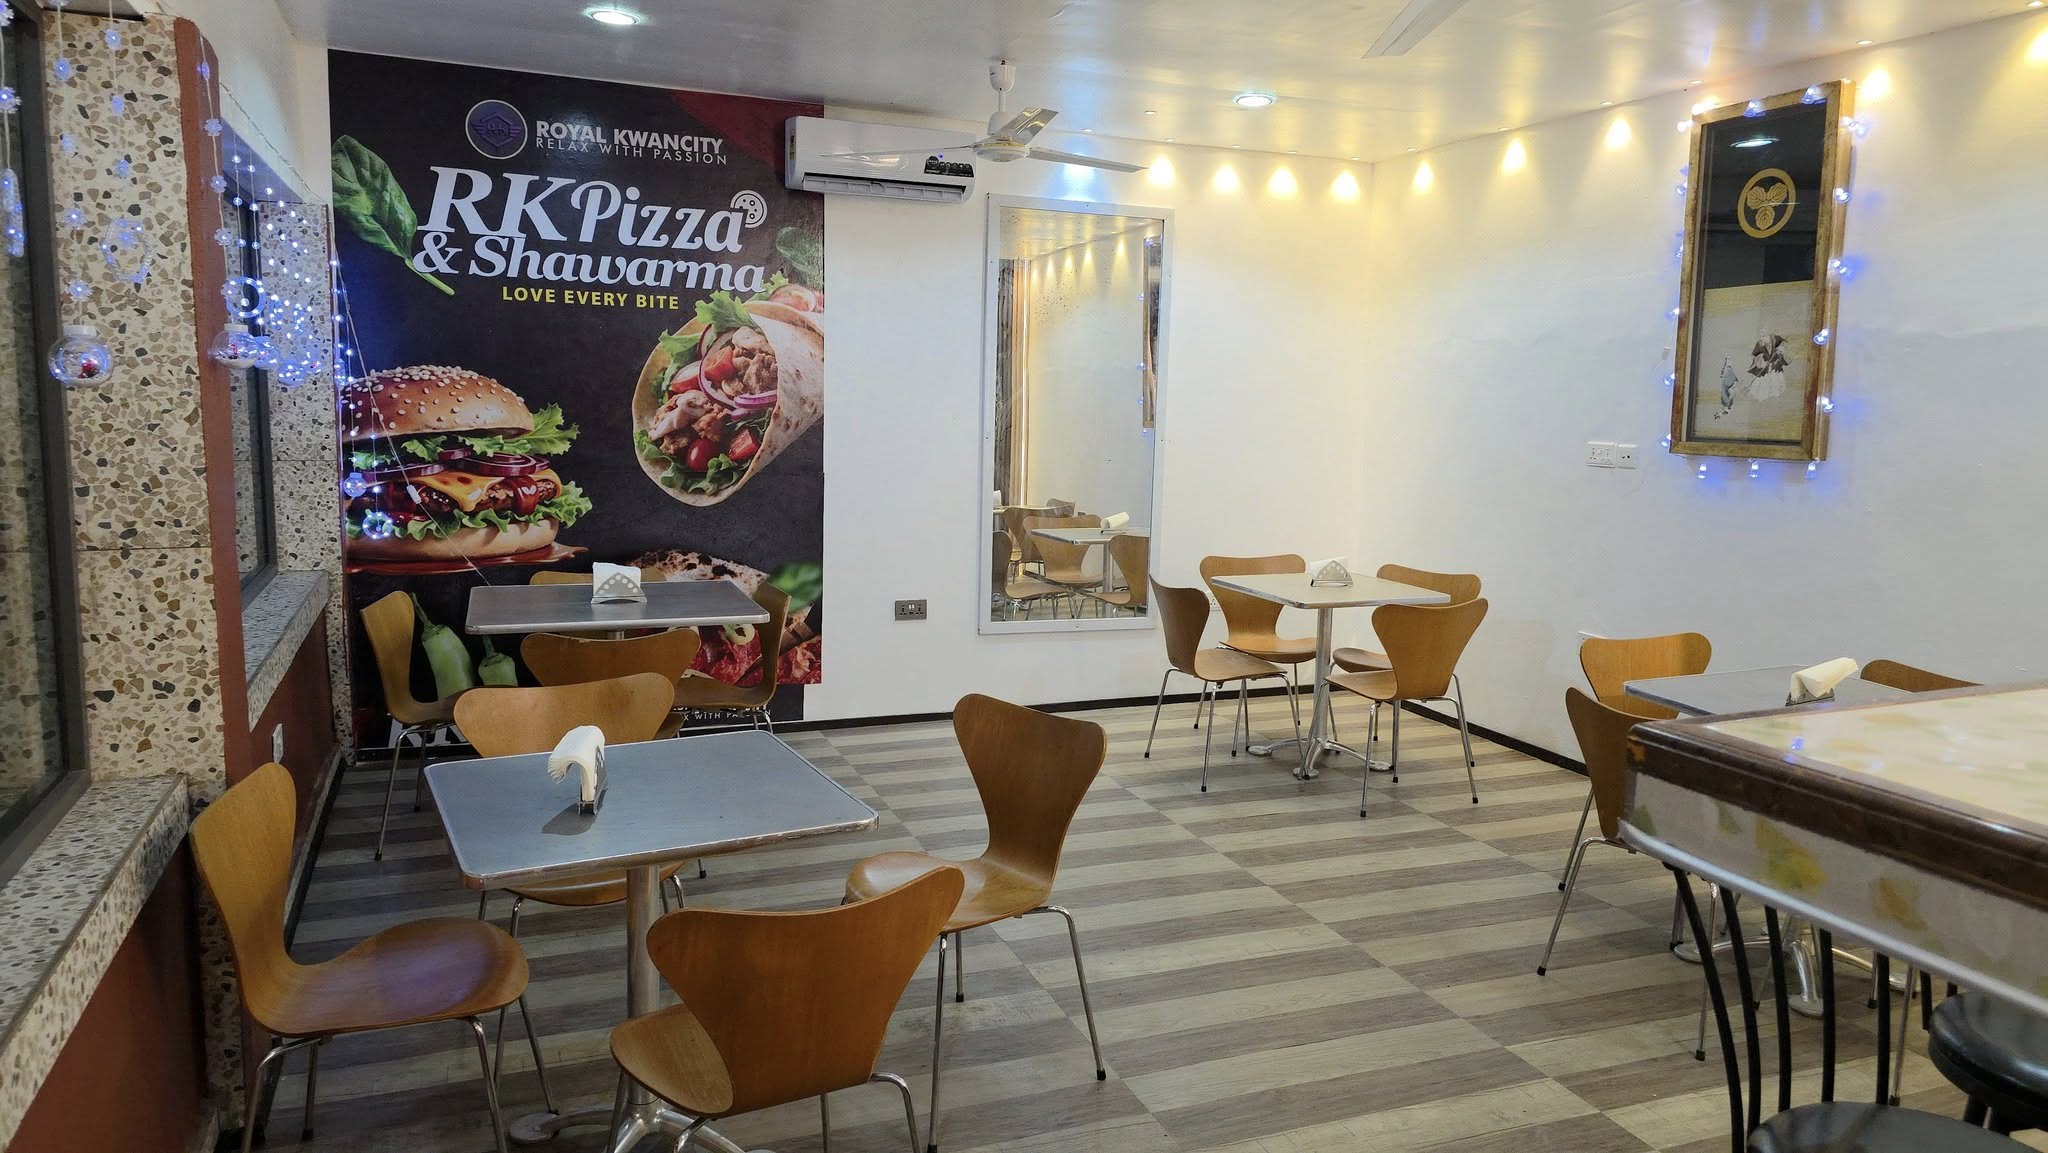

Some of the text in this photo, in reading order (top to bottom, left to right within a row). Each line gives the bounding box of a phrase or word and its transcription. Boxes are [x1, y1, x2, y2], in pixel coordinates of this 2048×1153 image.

[536, 120, 724, 154] ROYAL KWANCITY
[536, 138, 727, 165] RELAX WITH PASSION
[416, 166, 744, 253] RK Pizza
[412, 231, 767, 293] & Shawarma
[502, 286, 679, 310] LOVE EVERY BITE
[694, 712, 721, 720] WITH
